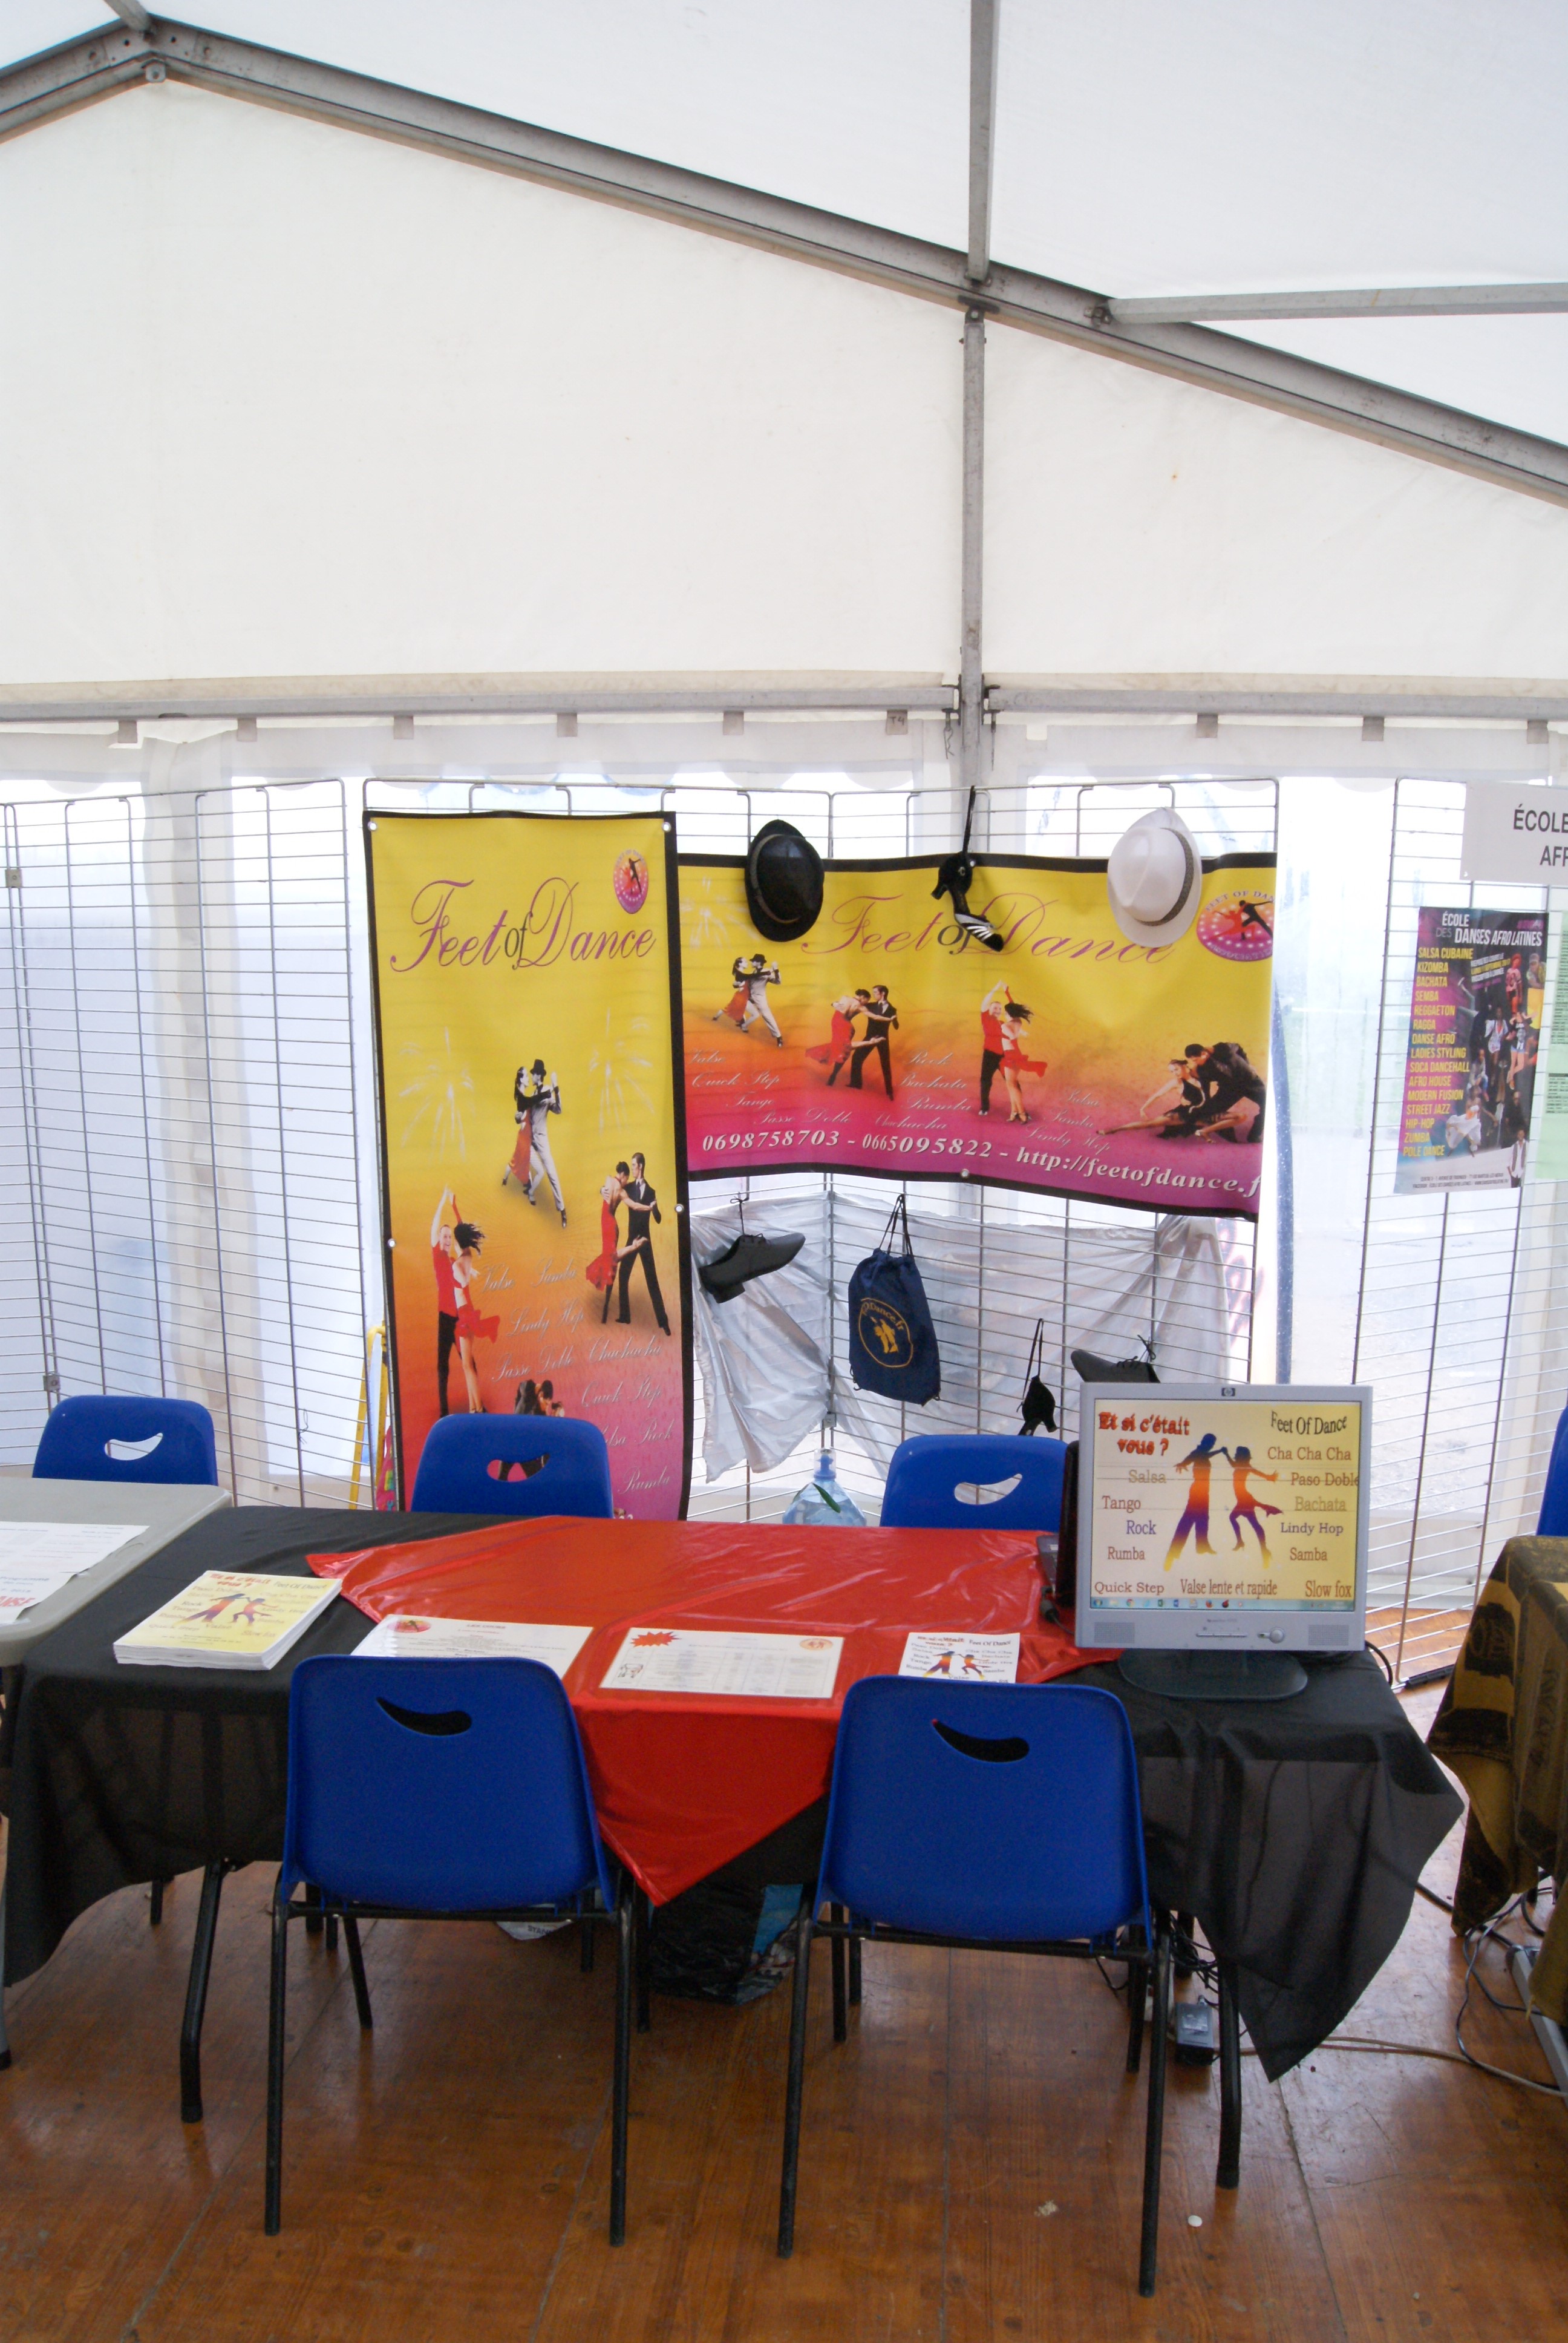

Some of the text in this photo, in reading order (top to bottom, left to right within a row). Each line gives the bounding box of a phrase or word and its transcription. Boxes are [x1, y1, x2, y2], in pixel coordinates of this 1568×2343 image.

[1514, 804, 1568, 833] ÉCOLE
[390, 877, 657, 972] Feet of Dance
[1442, 911, 1470, 927] ÉCOLE
[801, 893, 944, 954] Feet
[958, 893, 1177, 963] Dance
[1436, 927, 1452, 937] DES
[1455, 928, 1491, 945] DANSES
[1418, 947, 1439, 958] SALSA
[1441, 948, 1474, 960] CUBAINE
[1417, 962, 1449, 973] KIZOMBA
[1416, 976, 1448, 987] BACHATA
[1414, 1005, 1455, 1016] REGGAETON
[1412, 1034, 1455, 1044] DANSE AFRO
[1411, 1047, 1466, 1059] LADIES STYLING
[1410, 1062, 1470, 1073] SOCA DANCEHALL
[1409, 1075, 1451, 1087] AFRO HOUSE
[1408, 1090, 1464, 1101] MODERN FUSION
[1406, 1104, 1451, 1115] STREET JAZZ
[1406, 1118, 1435, 1129] HIP-HOP
[702, 1130, 840, 1151] 0698758703
[862, 1133, 993, 1158] 0665095822
[1404, 1132, 1430, 1142] ZUMBA
[1403, 1145, 1445, 1156] POLE DANCE
[1099, 1412, 1190, 1435] Et si c'était
[1271, 1410, 1347, 1435] Feet Of Dance
[1117, 1438, 1155, 1455] vous
[1267, 1446, 1351, 1461] Cha Cha Cha
[1129, 1469, 1167, 1483] Salsa
[1291, 1472, 1359, 1486] Paso Doble
[1102, 1495, 1141, 1513] Tango
[1295, 1496, 1347, 1511] Bachata
[1126, 1519, 1156, 1535] Rock
[1281, 1522, 1344, 1536] Lindy Hop
[1108, 1546, 1145, 1560] Rumba
[1290, 1547, 1327, 1561] Samba
[1094, 1581, 1165, 1595] Quick Step
[1180, 1579, 1278, 1599] Valse lente et rapide
[1305, 1580, 1352, 1598] Slow fox
